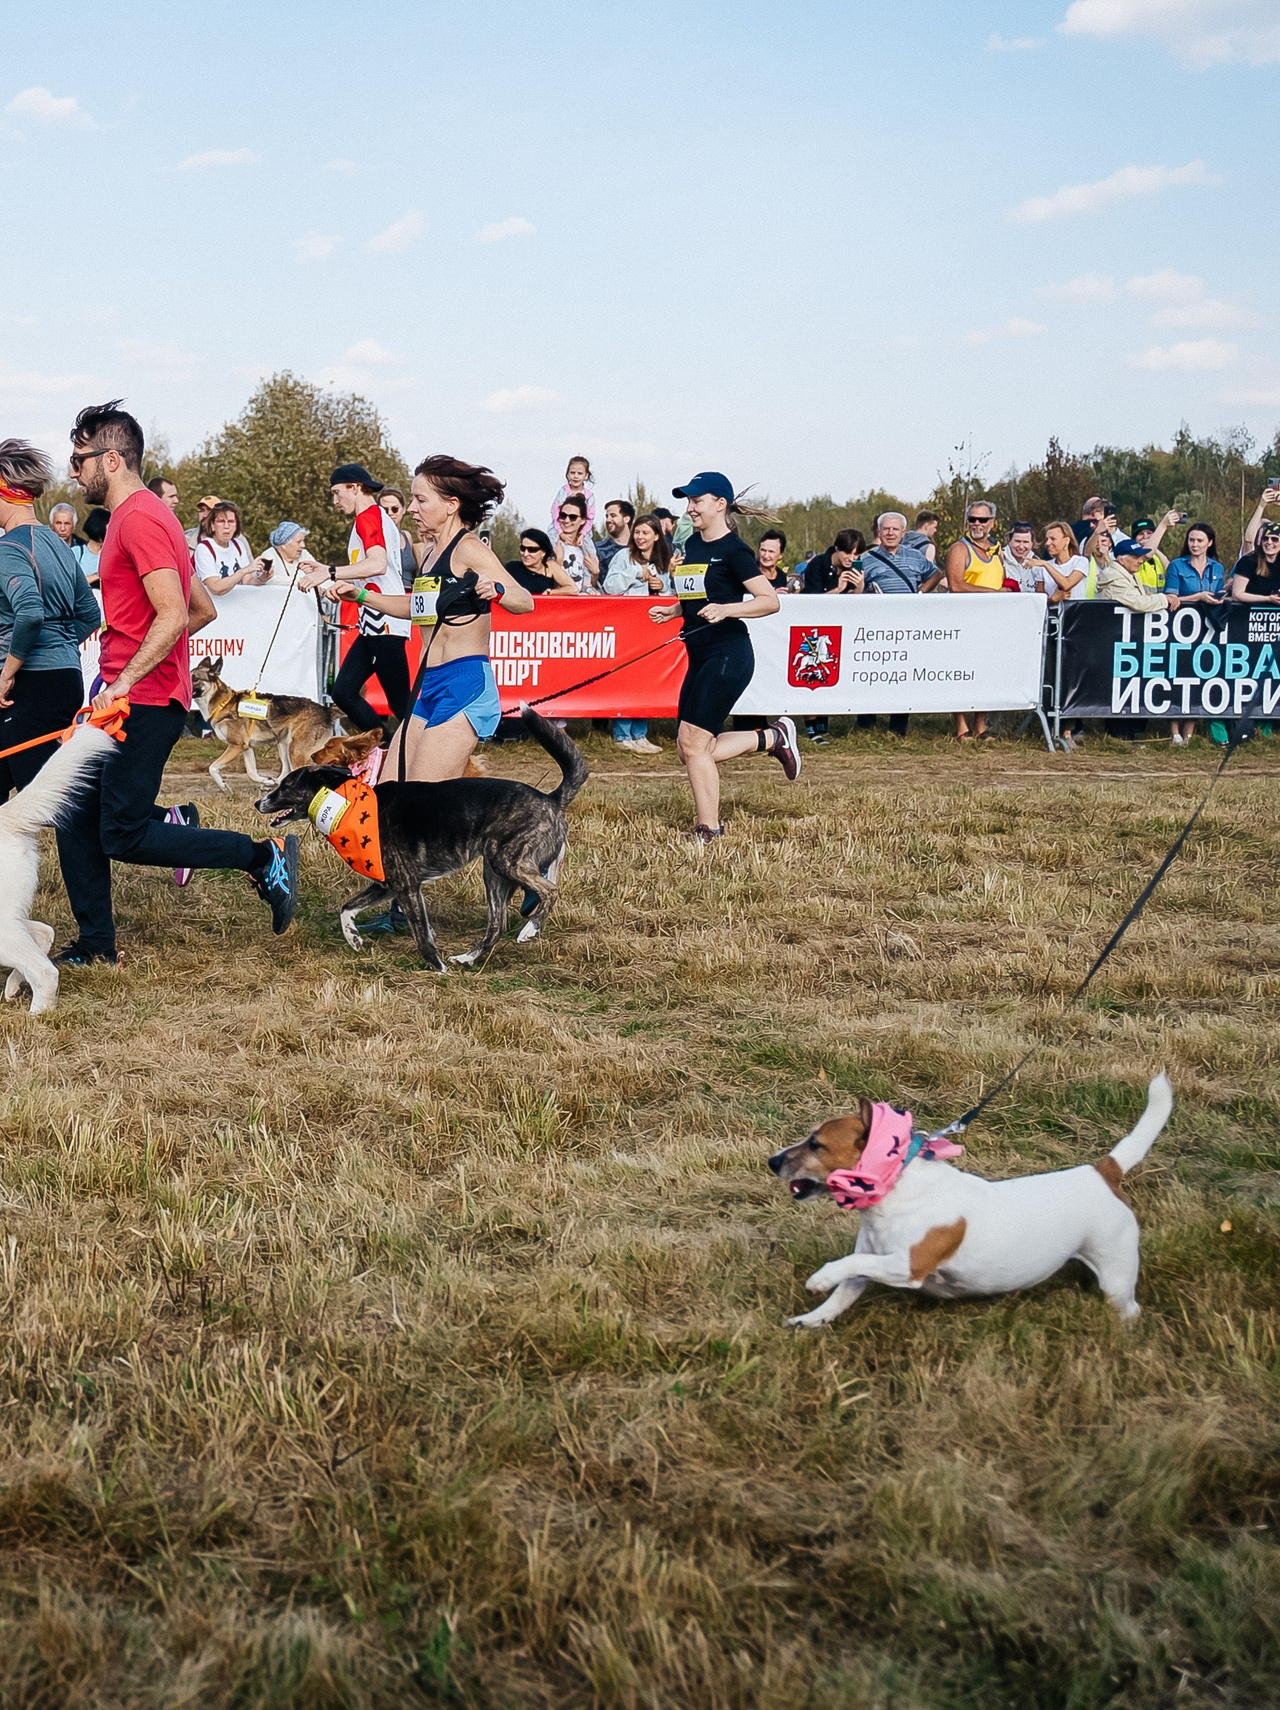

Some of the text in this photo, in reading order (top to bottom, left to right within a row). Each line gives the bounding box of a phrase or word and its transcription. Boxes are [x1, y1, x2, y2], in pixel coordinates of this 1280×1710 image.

[683, 577, 695, 591] 42
[414, 595, 425, 614] 58
[853, 626, 962, 645] Департамент
[1248, 622, 1267, 632] МЫ
[188, 638, 245, 657] ВСКОМУ
[853, 650, 908, 665] спорта
[490, 659, 543, 686] ПОРТ
[852, 667, 975, 686] города Москвы
